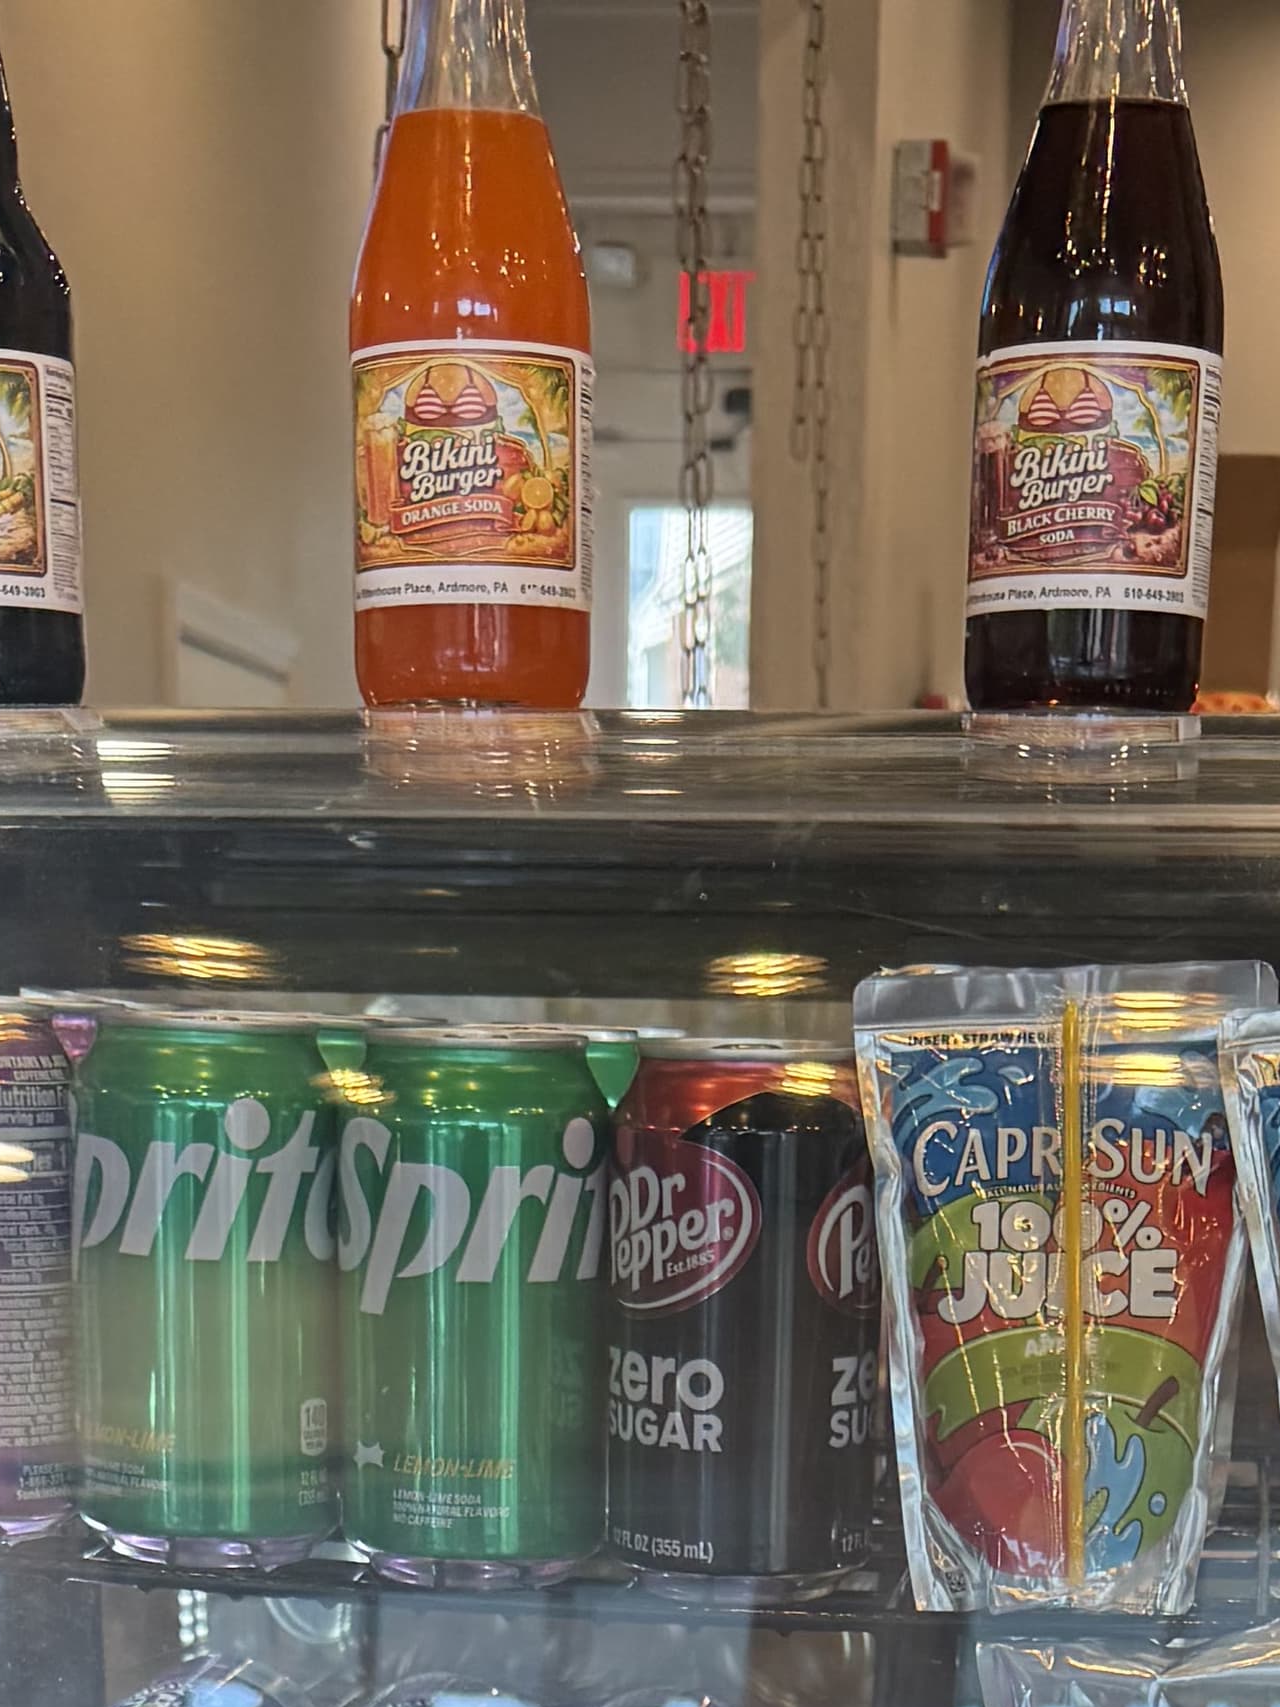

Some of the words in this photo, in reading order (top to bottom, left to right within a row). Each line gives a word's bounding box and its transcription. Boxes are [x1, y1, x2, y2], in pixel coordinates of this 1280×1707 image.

[400, 436, 497, 479] Bikini
[1010, 441, 1108, 488] Bikini
[410, 467, 503, 502] Burger
[1019, 472, 1113, 510] Burger
[402, 502, 460, 526] ORANGE
[464, 499, 503, 513] SODA
[1007, 513, 1051, 537] BLACK
[1054, 507, 1115, 523] CHERRY
[1039, 530, 1075, 545] SODA
[494, 583, 508, 593] PA
[1095, 587, 1111, 598] PA
[962, 1031, 1016, 1046] STRAW
[912, 1121, 1063, 1198] CAPR
[1088, 1118, 1213, 1198] SUN
[72, 1098, 335, 1282] prit
[630, 1165, 686, 1232] Dr
[338, 1116, 609, 1314] Sprit
[971, 1198, 1162, 1251] 100%
[609, 1346, 725, 1411] zero
[609, 1400, 723, 1453] SUGAR
[393, 1453, 515, 1480] LEMON-LIME
[634, 1533, 649, 1553] OZ
[652, 1534, 681, 1559] (355
[683, 1539, 714, 1563] mL)
